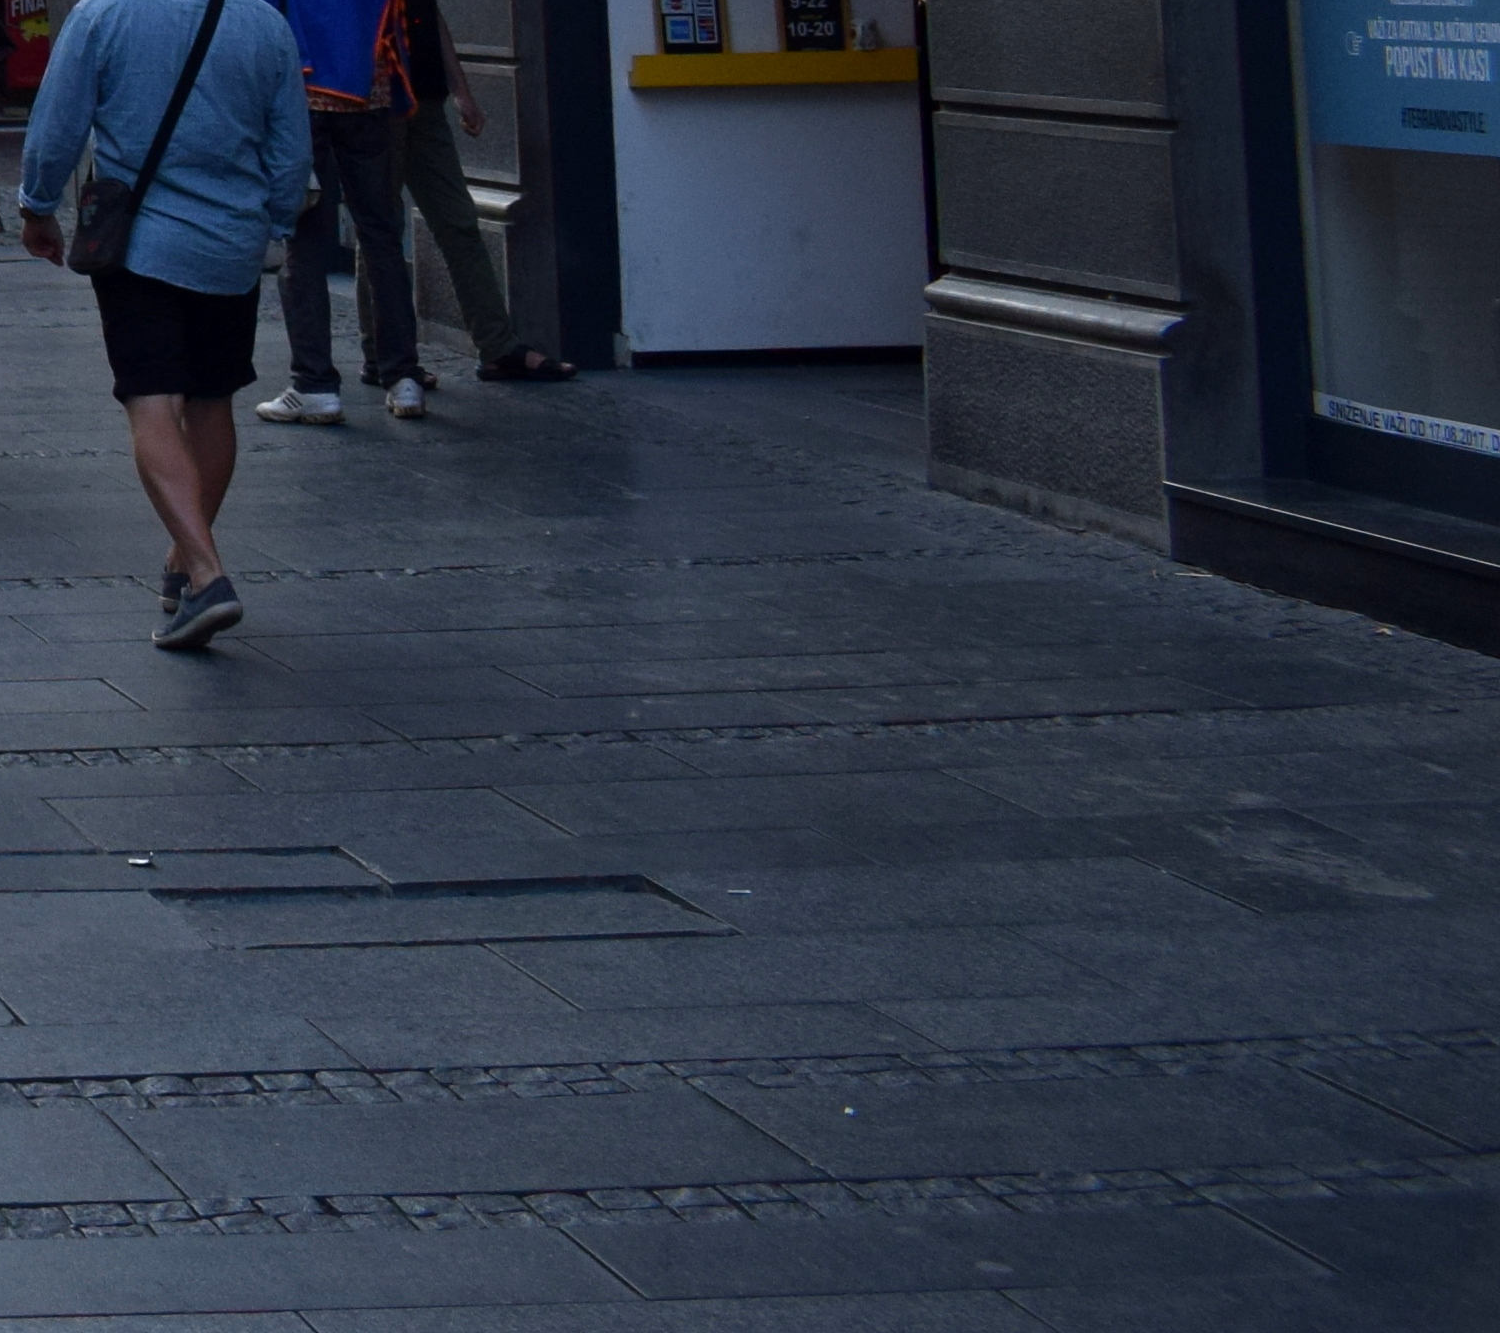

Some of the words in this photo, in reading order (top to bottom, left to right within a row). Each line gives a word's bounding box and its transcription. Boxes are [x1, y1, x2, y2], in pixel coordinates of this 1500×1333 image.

[787, 20, 835, 38] 10-20
[1385, 45, 1434, 79] POPUST
[1436, 47, 1457, 80] NA
[1458, 47, 1490, 82] KASI
